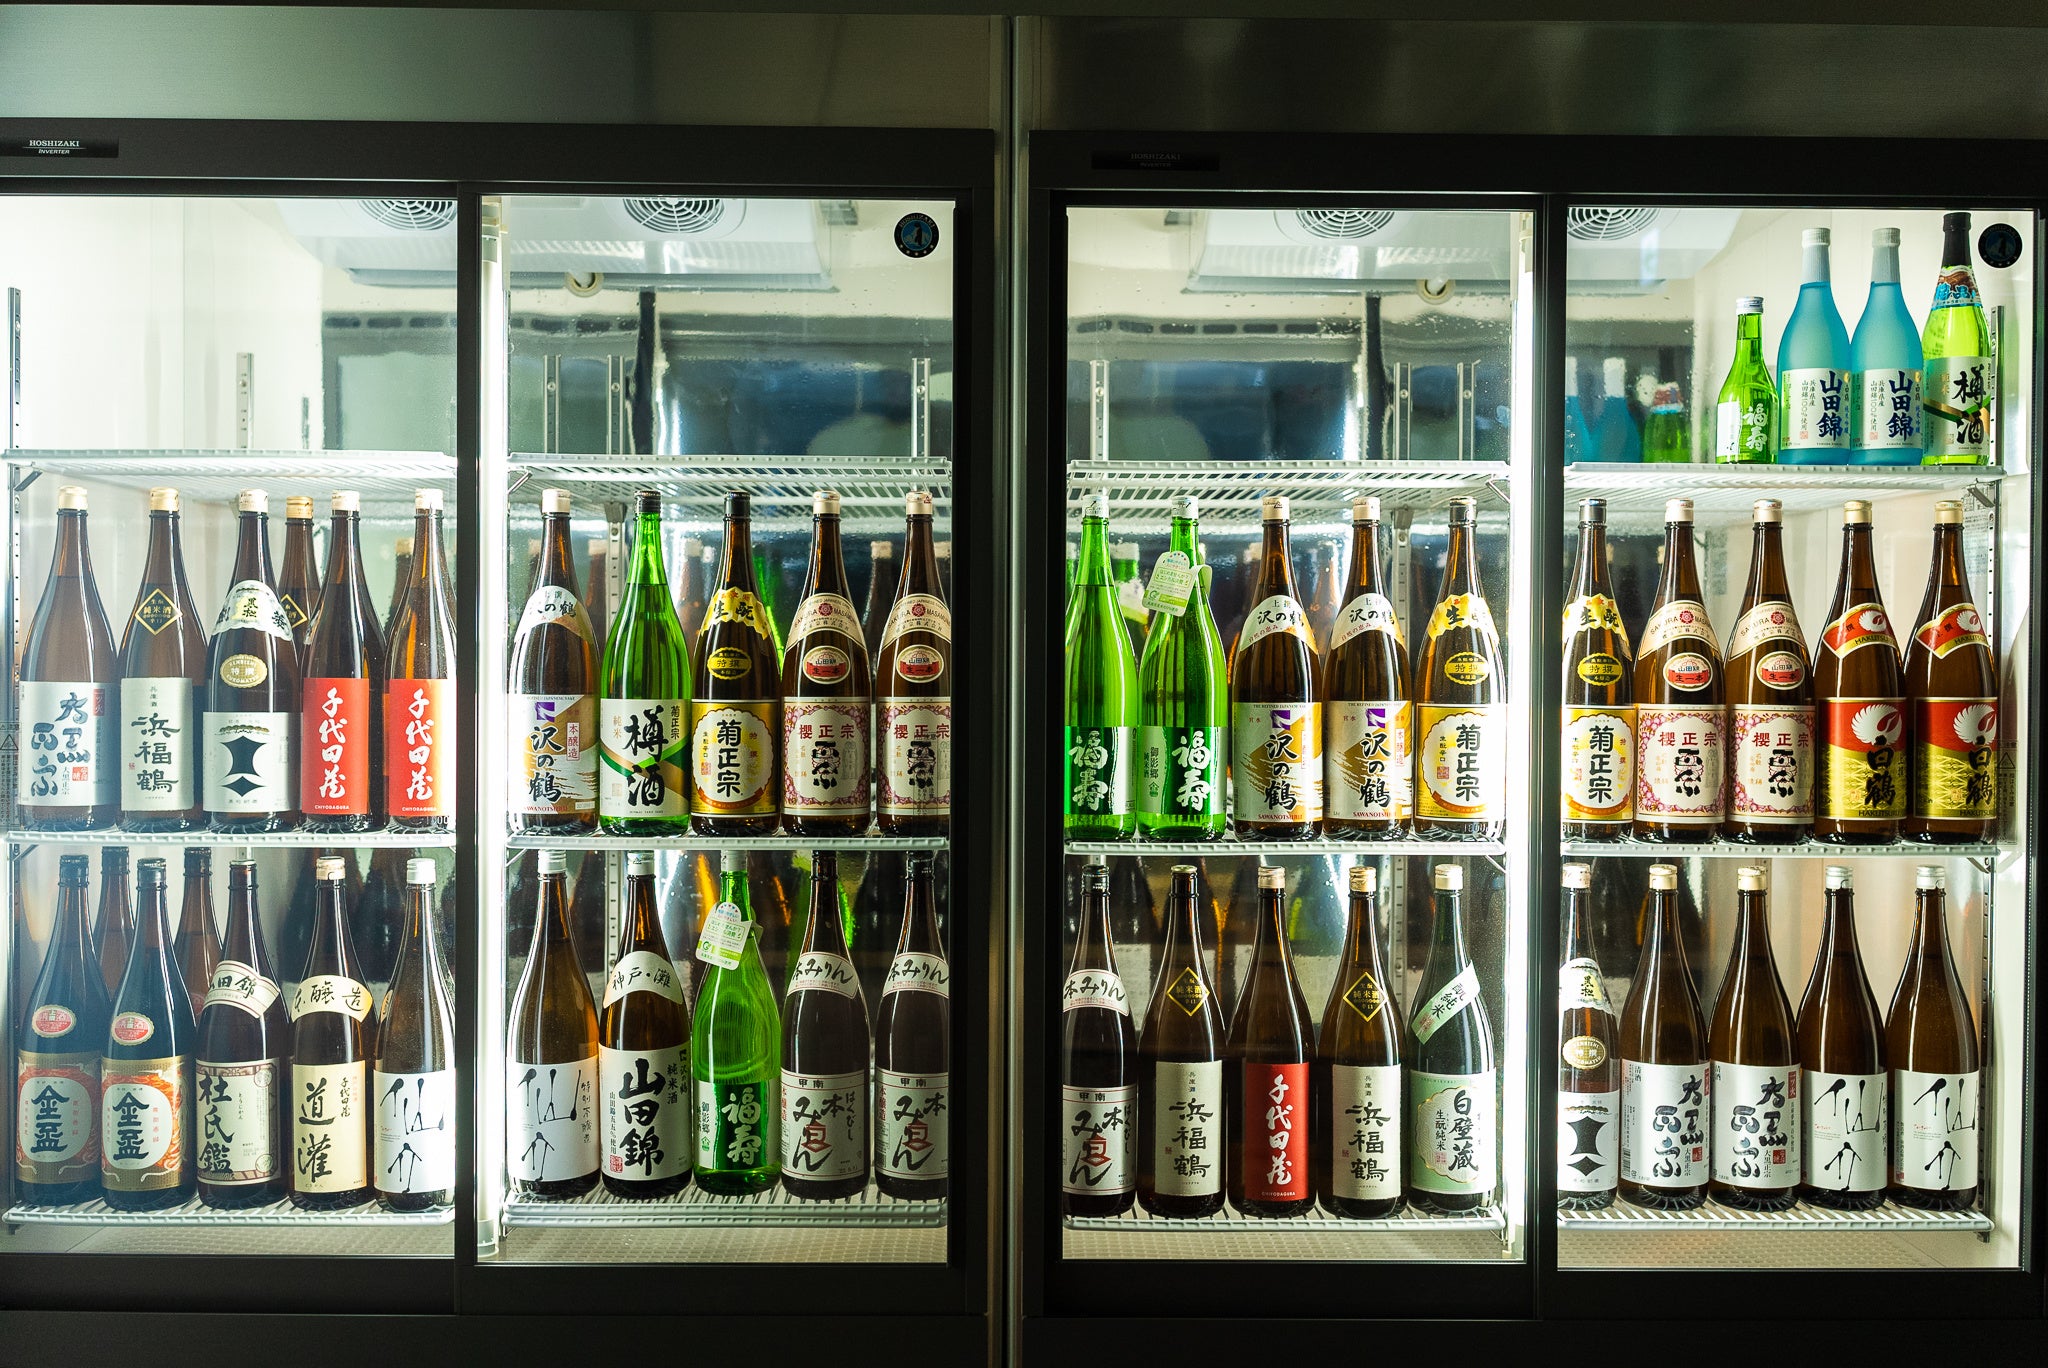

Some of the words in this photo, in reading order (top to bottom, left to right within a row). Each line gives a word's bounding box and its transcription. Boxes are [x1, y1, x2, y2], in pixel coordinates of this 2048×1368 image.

[1816, 371, 1843, 441] 山田錦
[1886, 371, 1914, 441] 山田錦
[1953, 363, 1986, 445] 樽酒
[242, 597, 258, 618] 黒松
[1580, 606, 1620, 627] 生酛
[1675, 674, 1704, 682] 生一本
[1768, 673, 1797, 682] 生一本
[569, 724, 578, 759] 本醸造
[613, 715, 621, 739] 純米
[671, 705, 681, 740] 菊正宗
[799, 724, 855, 739] 櫻正宗
[894, 724, 949, 739] 櫻正宗
[1658, 731, 1717, 746] 櫻正宗
[1752, 731, 1809, 747] 櫻正宗
[131, 713, 180, 793] 浜福鶴
[529, 726, 564, 803] 沢の鶴
[622, 705, 669, 807] 樽酒
[716, 719, 742, 798] 菊正宗
[1359, 733, 1392, 808] 沢の鶴
[1439, 735, 1447, 762] 生酛辛口
[1455, 723, 1481, 801] 菊正宗
[1588, 725, 1614, 803] 菊正宗
[1864, 735, 1896, 807] 白鶴
[1965, 735, 1993, 807] 白鶴
[1263, 734, 1299, 811] 沢の鶴
[612, 966, 671, 990] 神戸・灘
[792, 958, 854, 988] 本みりん
[888, 958, 949, 987] 本みりん
[1063, 975, 1126, 1001] 本みりん
[1353, 990, 1380, 999] 純米酒
[1580, 975, 1594, 997] 黒松
[667, 1063, 678, 1104] 純米酒
[799, 1079, 824, 1089] 甲南
[901, 1078, 927, 1088] 甲南
[1079, 1092, 1106, 1102] 甲南
[198, 1071, 233, 1174] 杜氏鑑
[298, 1078, 335, 1183] 道灌
[517, 1068, 582, 1182] 仙介
[619, 1058, 666, 1177] 山田錦
[845, 1091, 855, 1142] はくびし
[1123, 1104, 1132, 1154] はくびし
[1169, 1097, 1214, 1178] 浜福鶴
[1435, 1109, 1447, 1151] 生酛純米
[1449, 1089, 1480, 1172] 白壁蔵
[1814, 1078, 1884, 1191] 仙介
[1345, 1101, 1391, 1182] 浜福鶴
